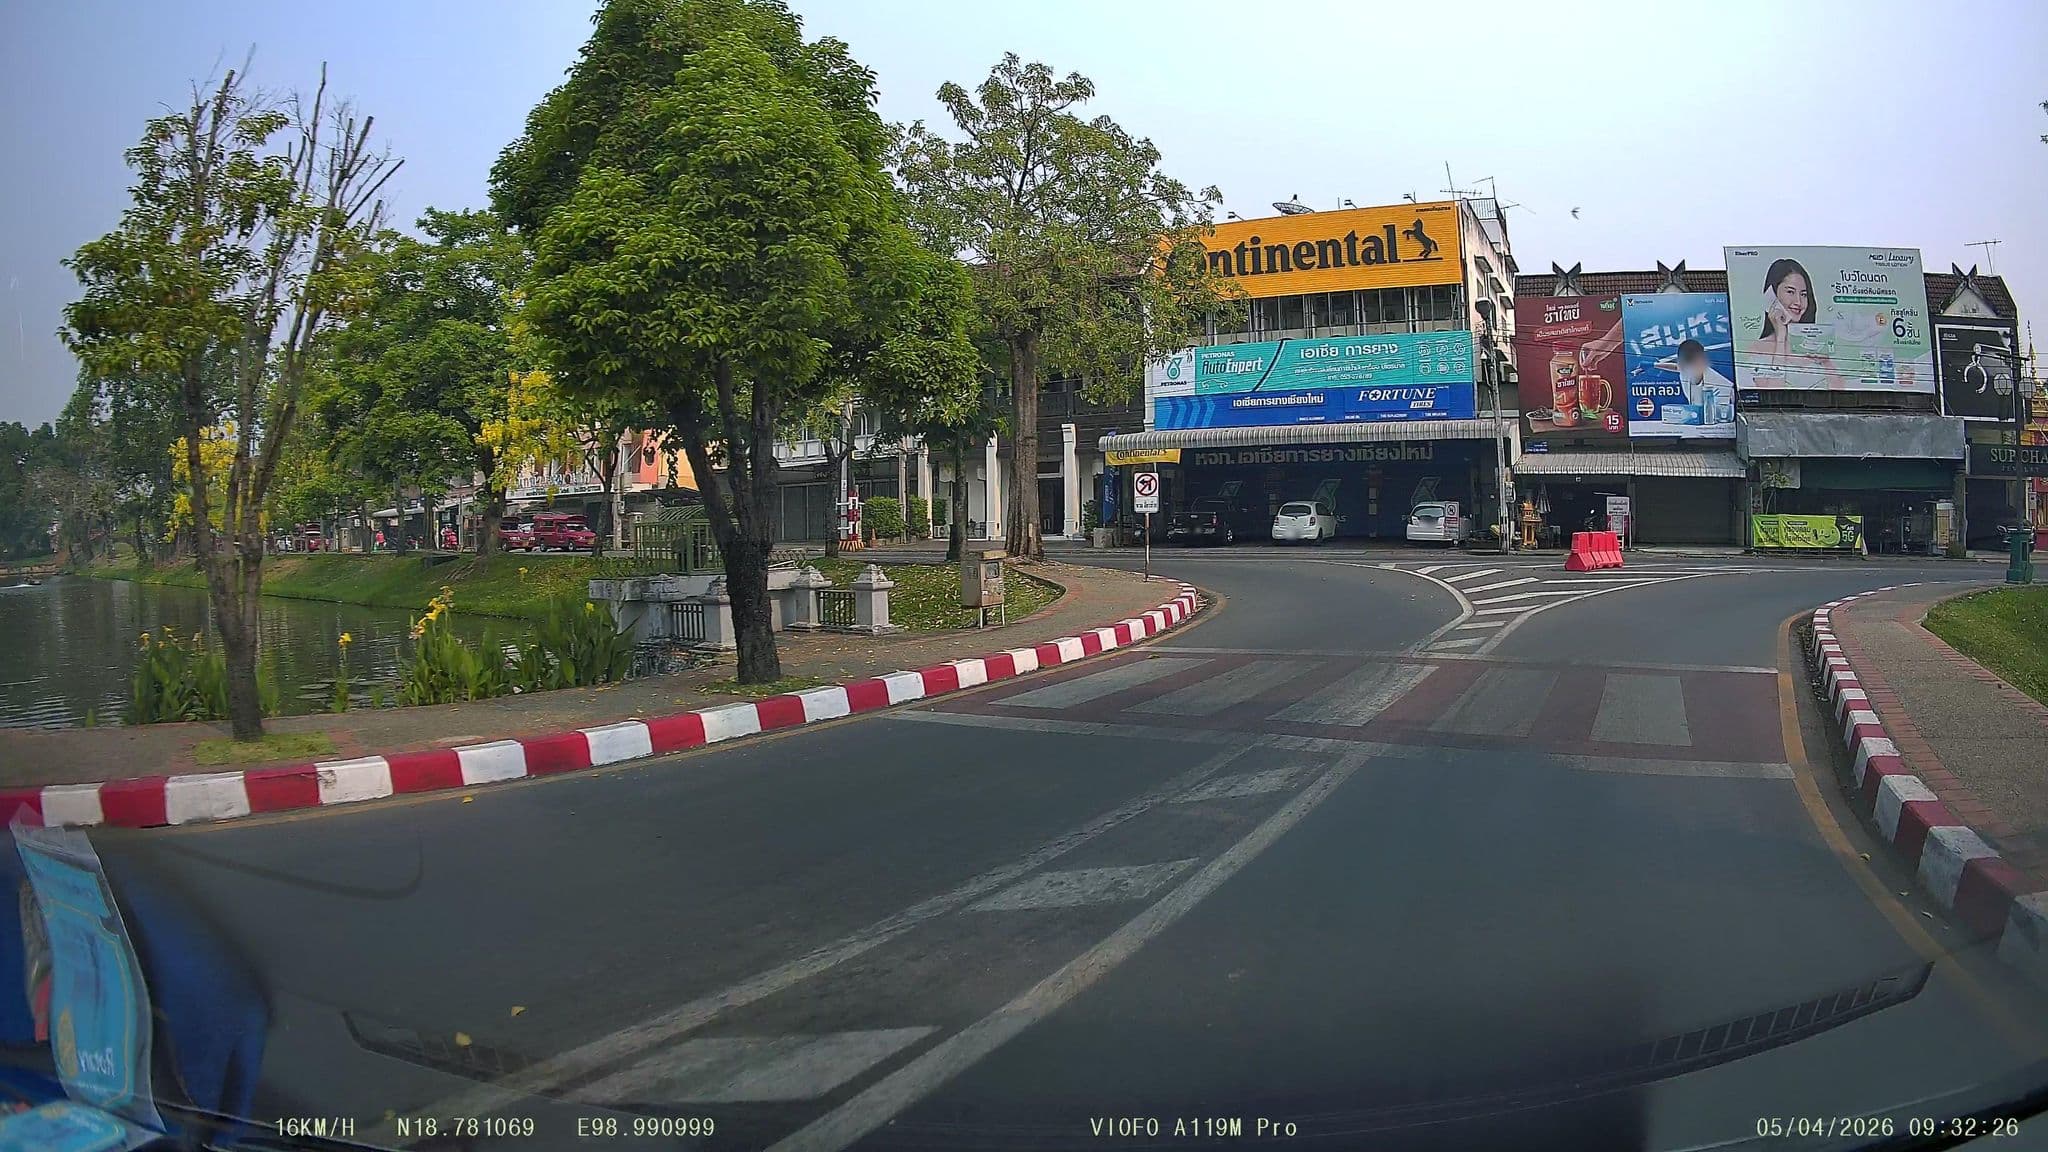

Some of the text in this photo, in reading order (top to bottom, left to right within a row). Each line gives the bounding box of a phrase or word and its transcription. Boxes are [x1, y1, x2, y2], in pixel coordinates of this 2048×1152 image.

[1165, 224, 1401, 278] ntinental
[1544, 306, 1580, 324] ชาไทย
[1893, 317, 1906, 338] 6
[1201, 352, 1235, 360] PETRONAS
[1300, 343, 1399, 359] เอเชีย การยาง
[1631, 386, 1681, 396] แนค ลอง
[1233, 393, 1324, 408] เอเชียการยางเชียงใหม่
[1606, 415, 1619, 425] 15
[1841, 530, 1855, 542] 5G
